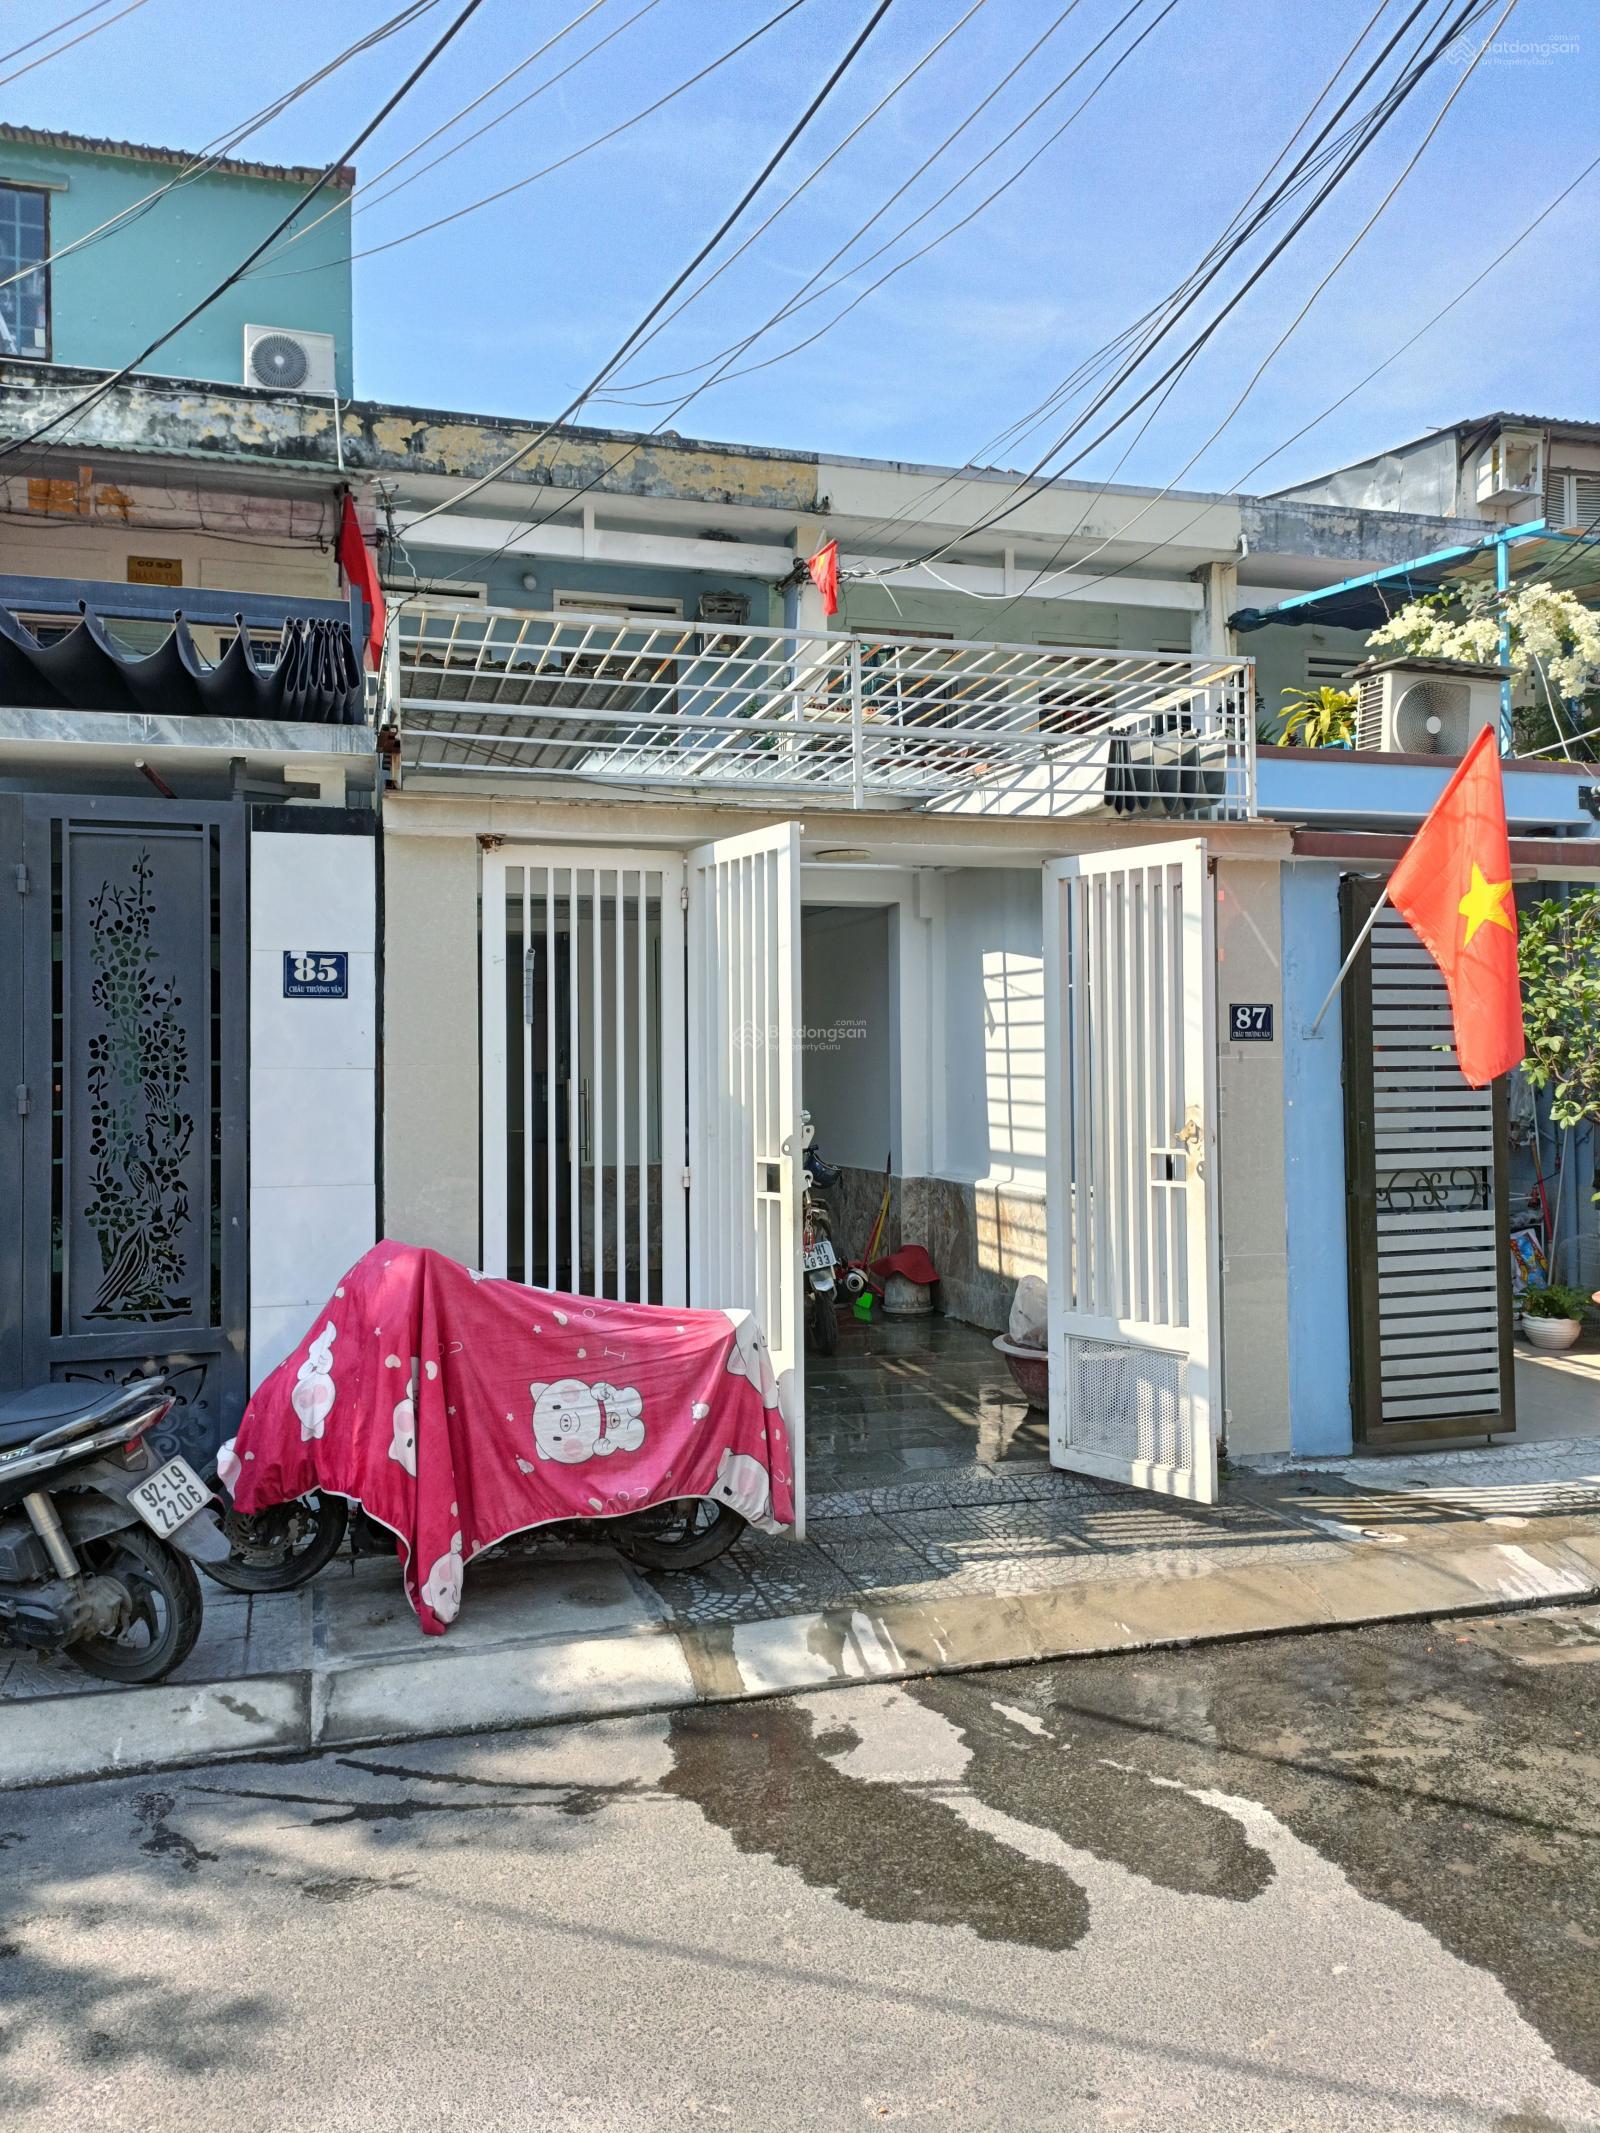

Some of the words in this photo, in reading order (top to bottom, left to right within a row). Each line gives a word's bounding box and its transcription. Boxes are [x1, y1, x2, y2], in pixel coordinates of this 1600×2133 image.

[293, 957, 338, 982] 85
[288, 985, 305, 993] CHÂU
[1236, 1007, 1267, 1029] 87
[156, 1484, 202, 1530] 2206
